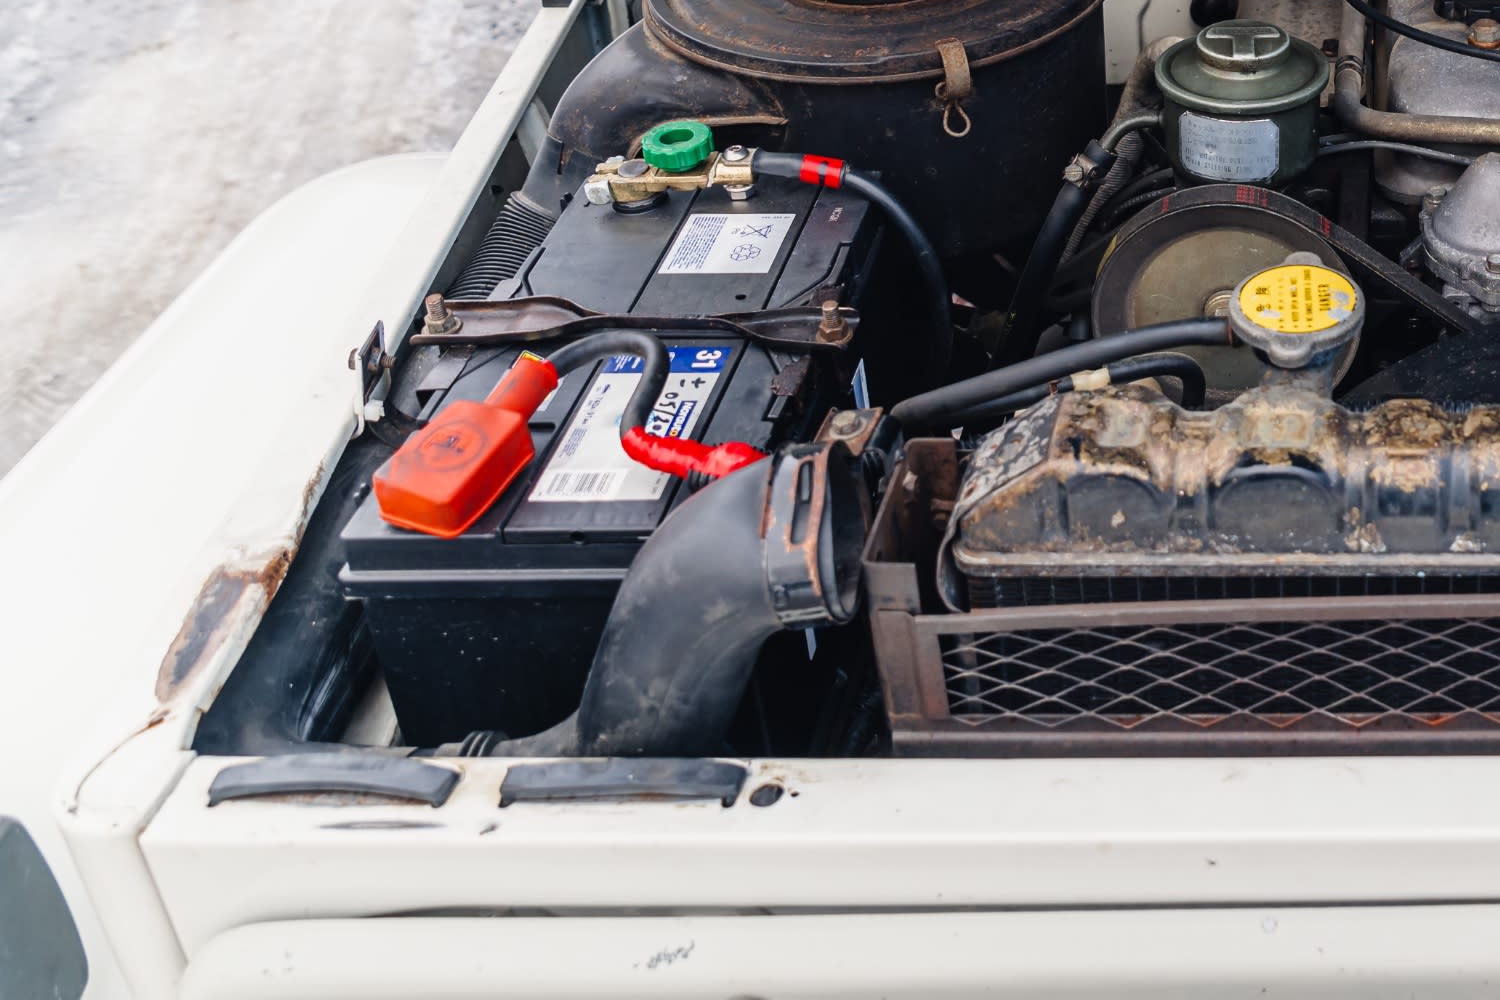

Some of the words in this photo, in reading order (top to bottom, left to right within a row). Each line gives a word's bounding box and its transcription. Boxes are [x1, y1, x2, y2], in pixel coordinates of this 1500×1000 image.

[691, 350, 722, 368] 31
[647, 392, 679, 436] 05/20
[669, 401, 695, 437] Norauto
